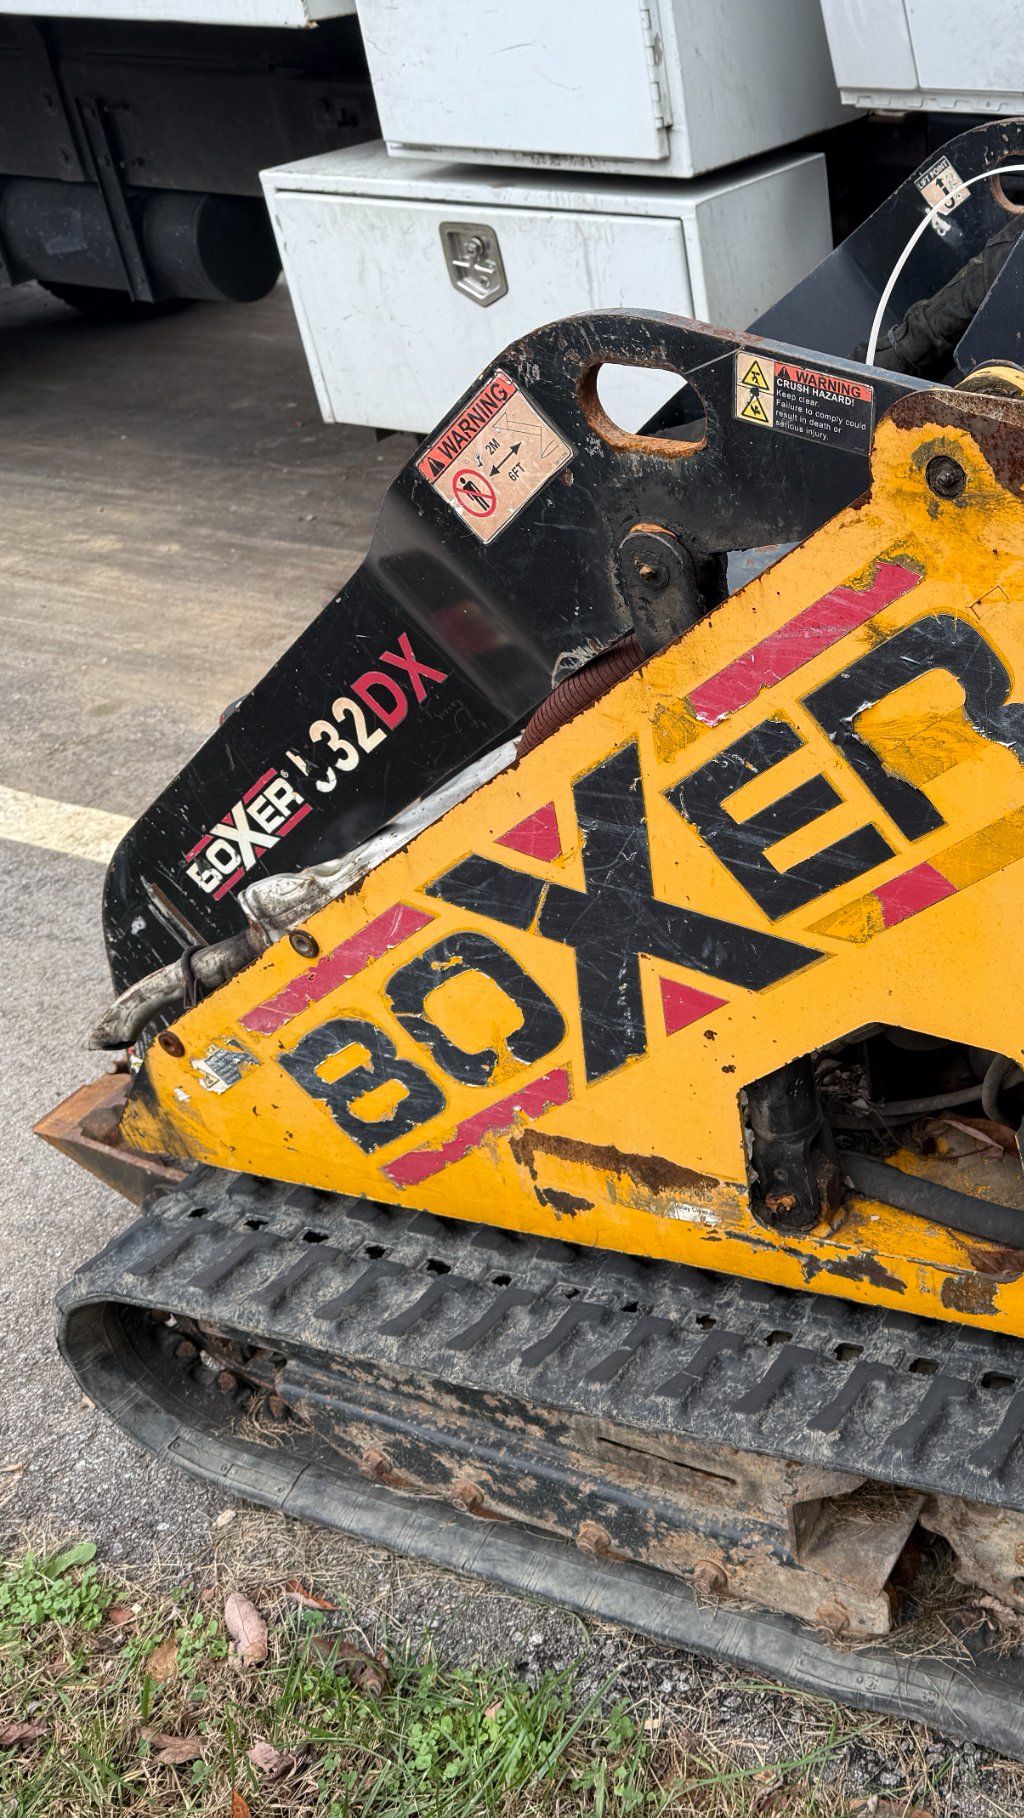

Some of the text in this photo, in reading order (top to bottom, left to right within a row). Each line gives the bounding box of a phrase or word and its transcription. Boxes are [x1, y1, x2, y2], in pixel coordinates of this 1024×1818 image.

[917, 161, 948, 188] LIFT POINT
[776, 378, 855, 406] CRUSH HAZARD!
[796, 370, 861, 398] WARNING
[776, 389, 820, 407] Keep clear.
[437, 382, 509, 459] WARNING
[775, 410, 842, 434] result in death or
[776, 398, 867, 430] Failure to comply could
[775, 420, 829, 440] serious injury.
[485, 438, 501, 456] 2M
[508, 462, 526, 481] 6FT
[186, 777, 305, 894] BOXER
